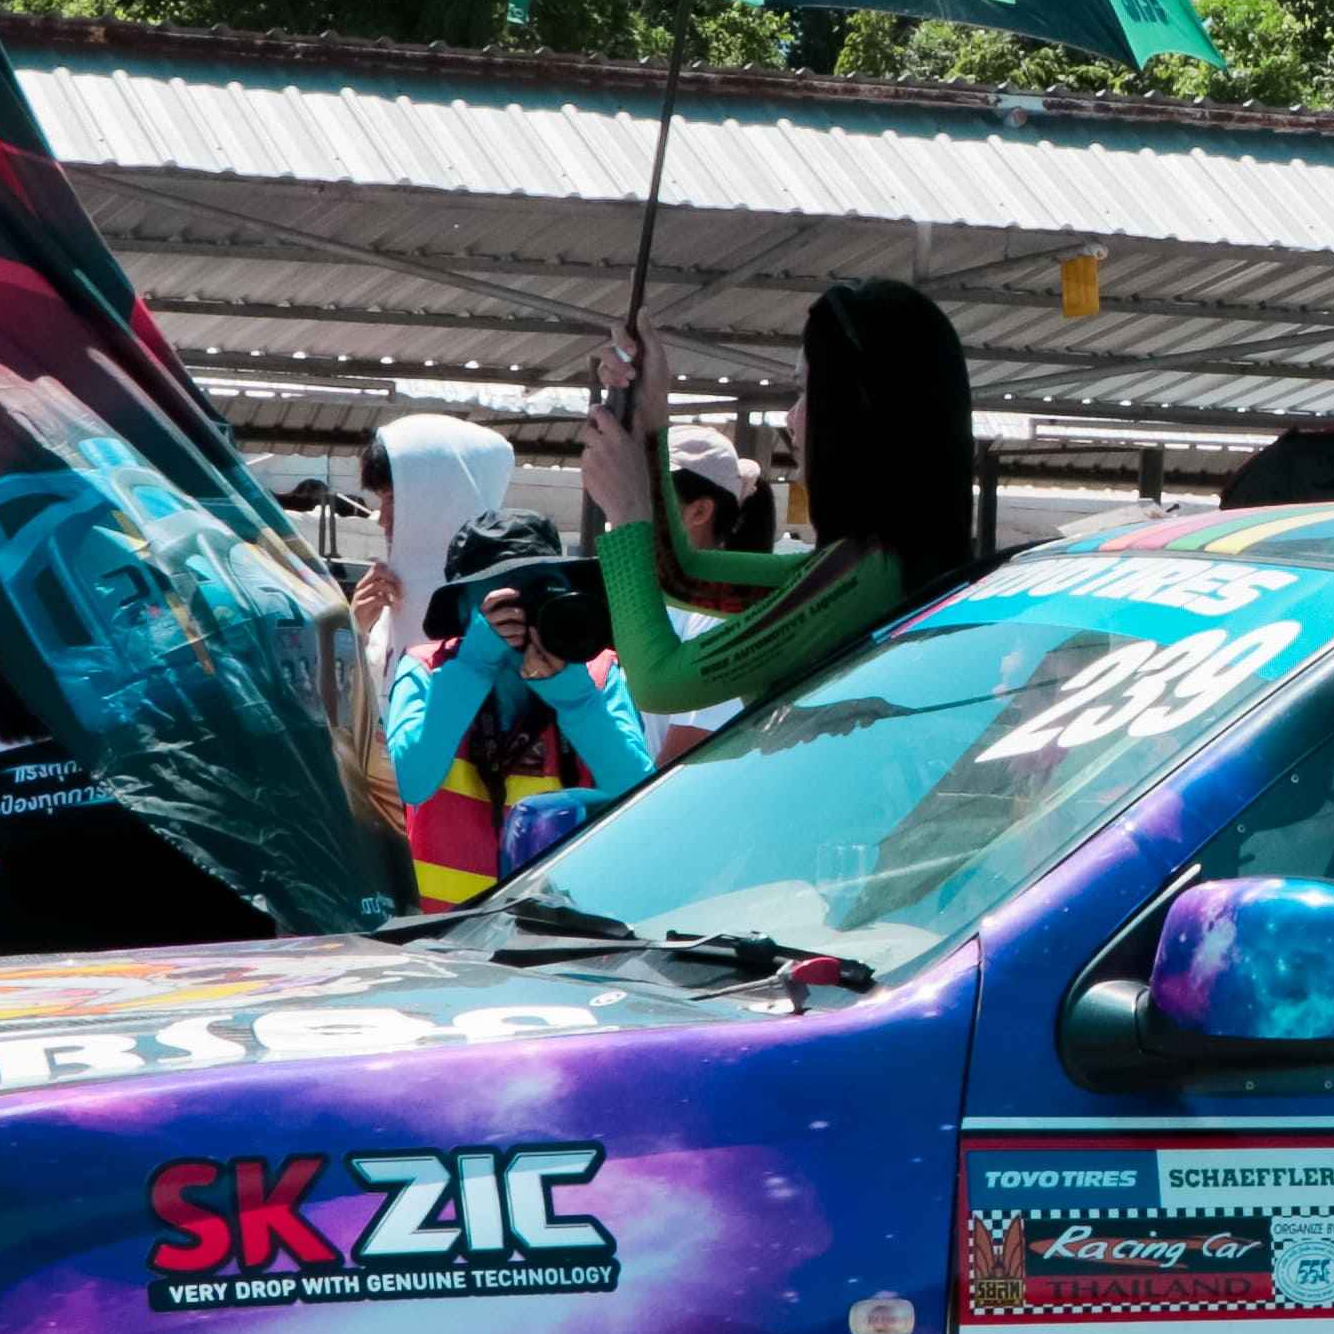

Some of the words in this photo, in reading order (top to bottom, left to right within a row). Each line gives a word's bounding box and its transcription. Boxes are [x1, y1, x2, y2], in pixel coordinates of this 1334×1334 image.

[1068, 555, 1300, 616] TIRES
[975, 620, 1302, 763] 239
[985, 1170, 1060, 1189] TOYO
[1061, 1169, 1138, 1188] TIRES
[151, 1157, 341, 1271] SK
[349, 1148, 608, 1258] ZIC
[1043, 1224, 1187, 1268] Racing
[1201, 1232, 1263, 1260] Car
[169, 1283, 228, 1305] VERY
[235, 1279, 297, 1302] DROP
[301, 1276, 361, 1296] WITH
[366, 1271, 467, 1293] GENUINE
[471, 1265, 613, 1289] TECHNOLOGY
[1047, 1276, 1253, 1301] THAILAND
